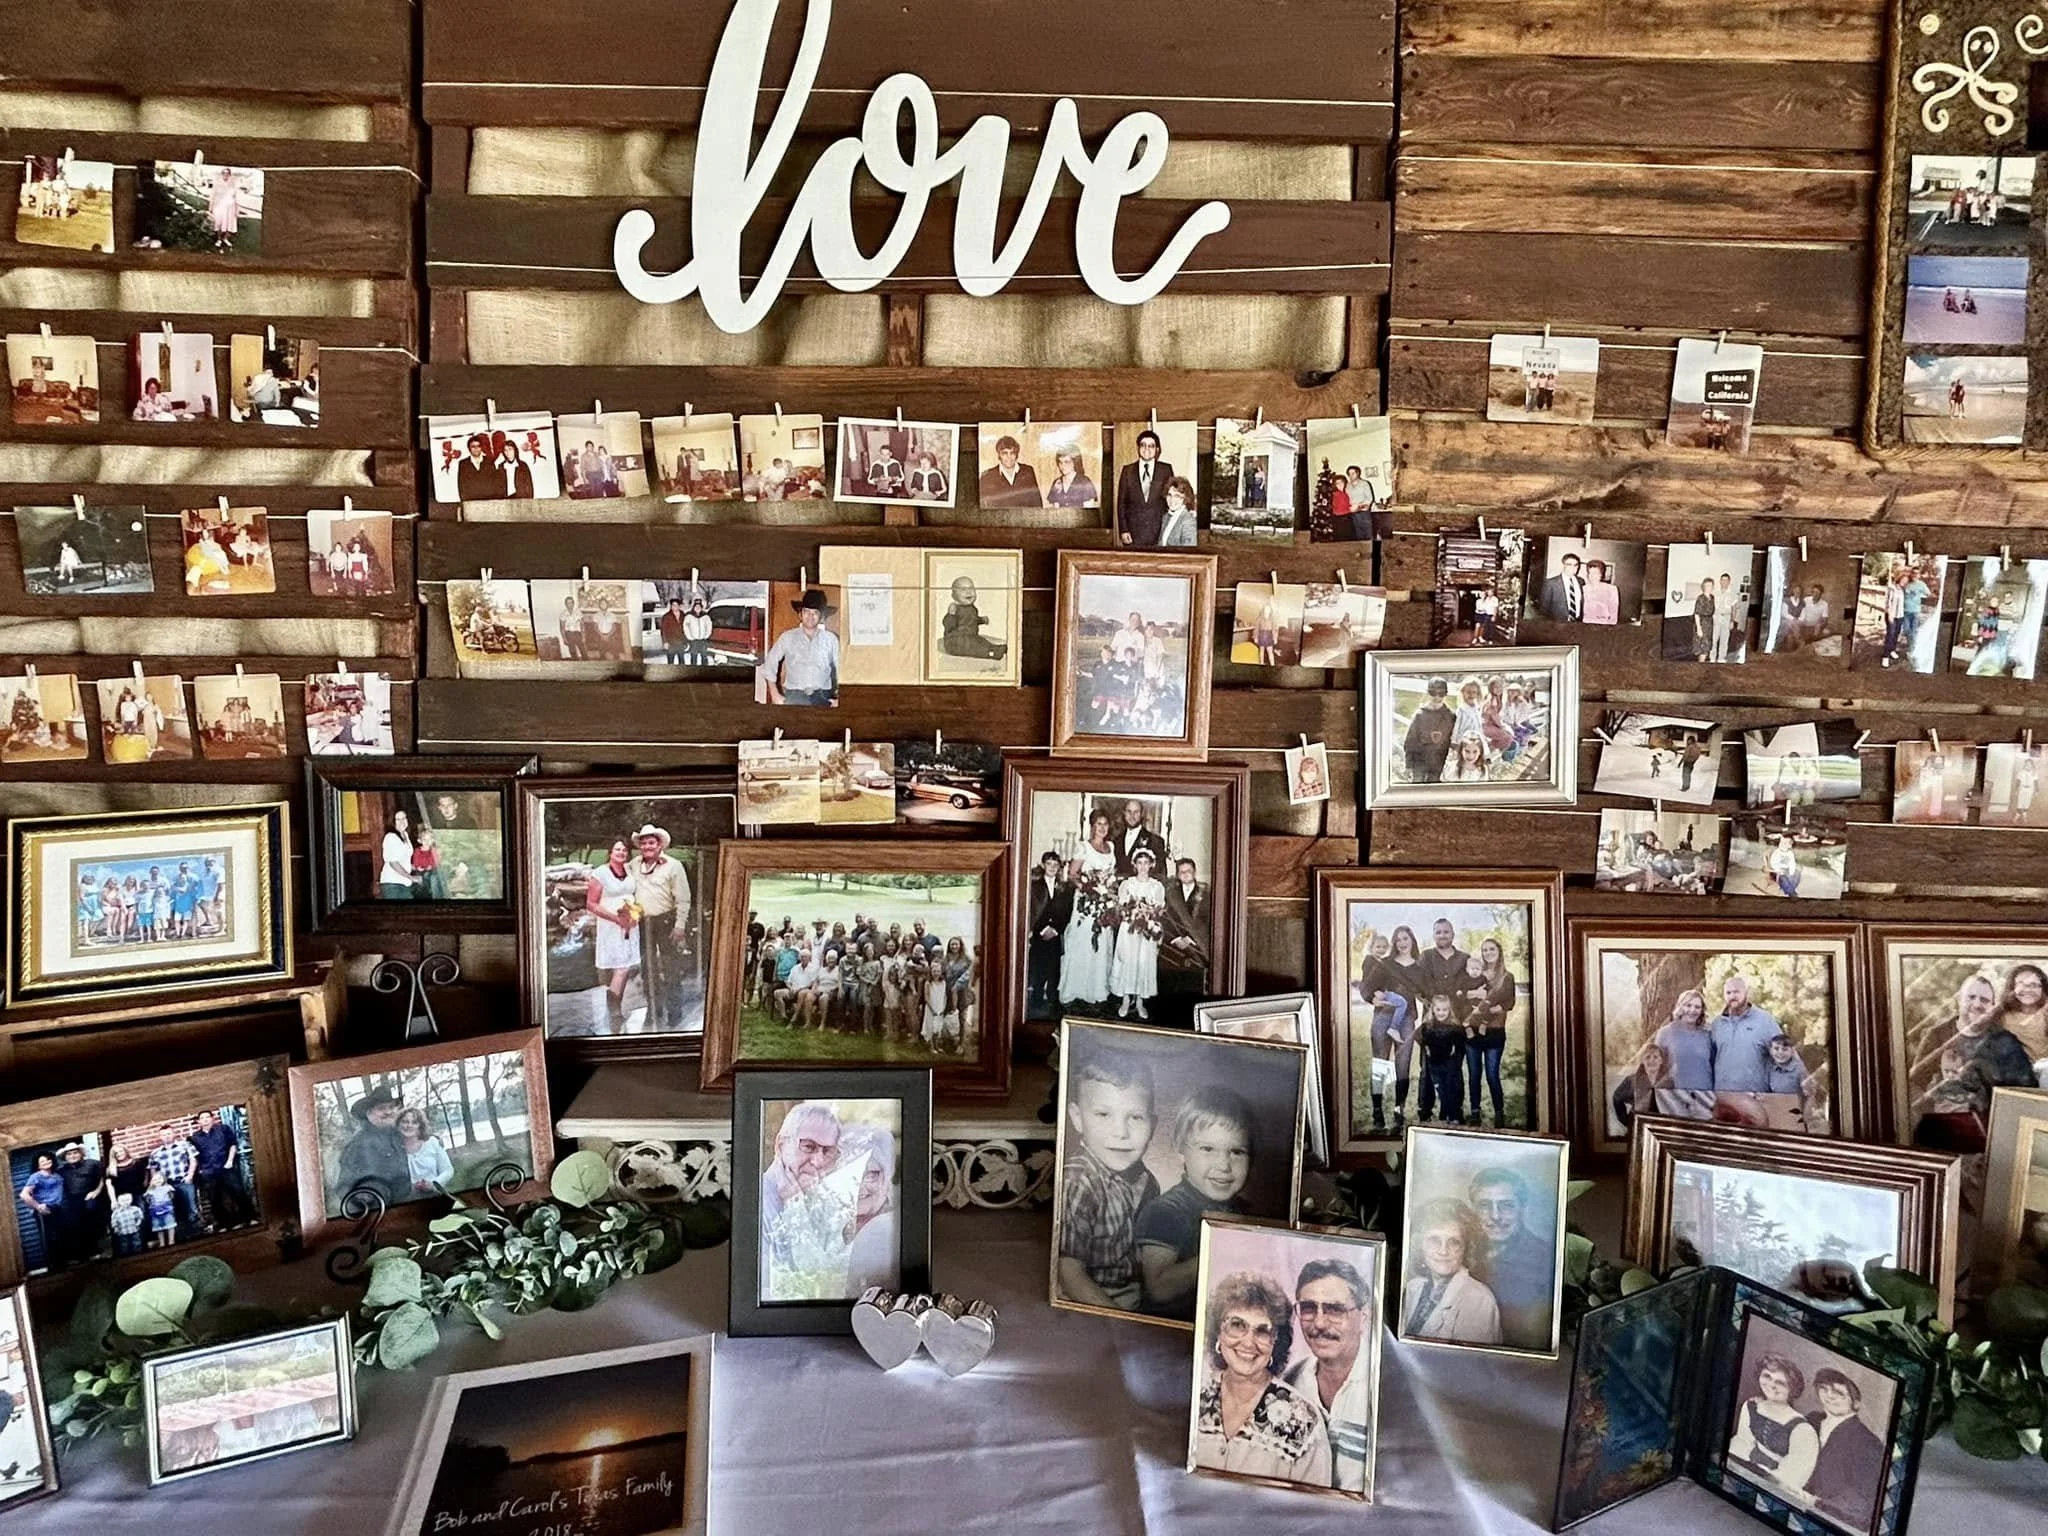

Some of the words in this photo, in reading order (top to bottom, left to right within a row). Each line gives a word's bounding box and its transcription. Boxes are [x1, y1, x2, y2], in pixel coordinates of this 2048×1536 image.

[613, 0, 1232, 334] love
[1526, 361, 1556, 369] Nevada
[1711, 374, 1748, 383] Welcome
[1724, 383, 1733, 391] to
[1707, 391, 1750, 400] California
[433, 1509, 469, 1532] Bob
[471, 1500, 510, 1524] and
[509, 1490, 568, 1517] Carol's
[625, 1471, 673, 1497] Family
